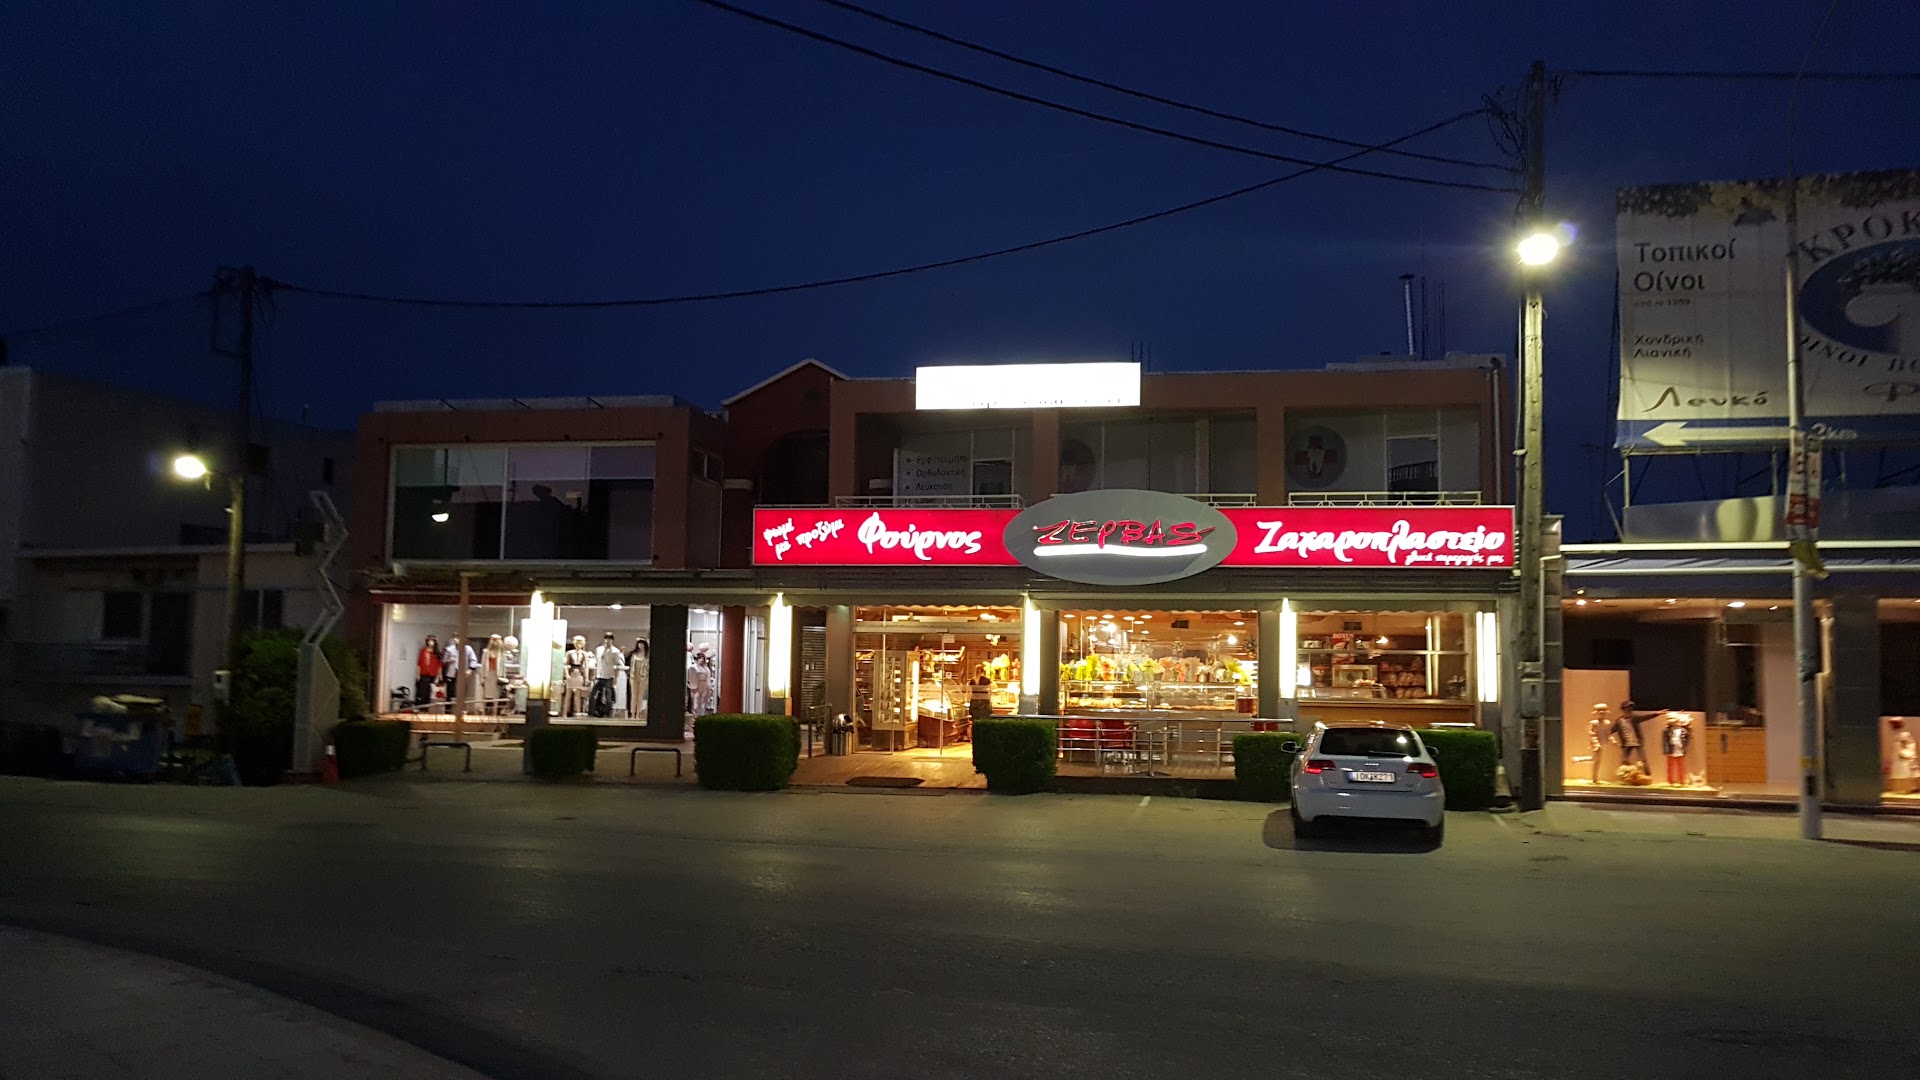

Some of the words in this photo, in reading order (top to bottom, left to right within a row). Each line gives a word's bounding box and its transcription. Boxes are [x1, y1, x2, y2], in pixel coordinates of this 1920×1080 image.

[1634, 238, 1736, 263] Τοπικοί
[1634, 272, 1704, 292] Οίνοι
[1634, 347, 1692, 358] Λιανική
[857, 511, 982, 560] Φούρνος
[1254, 520, 1505, 563] Ζαχαροπλαστείο
